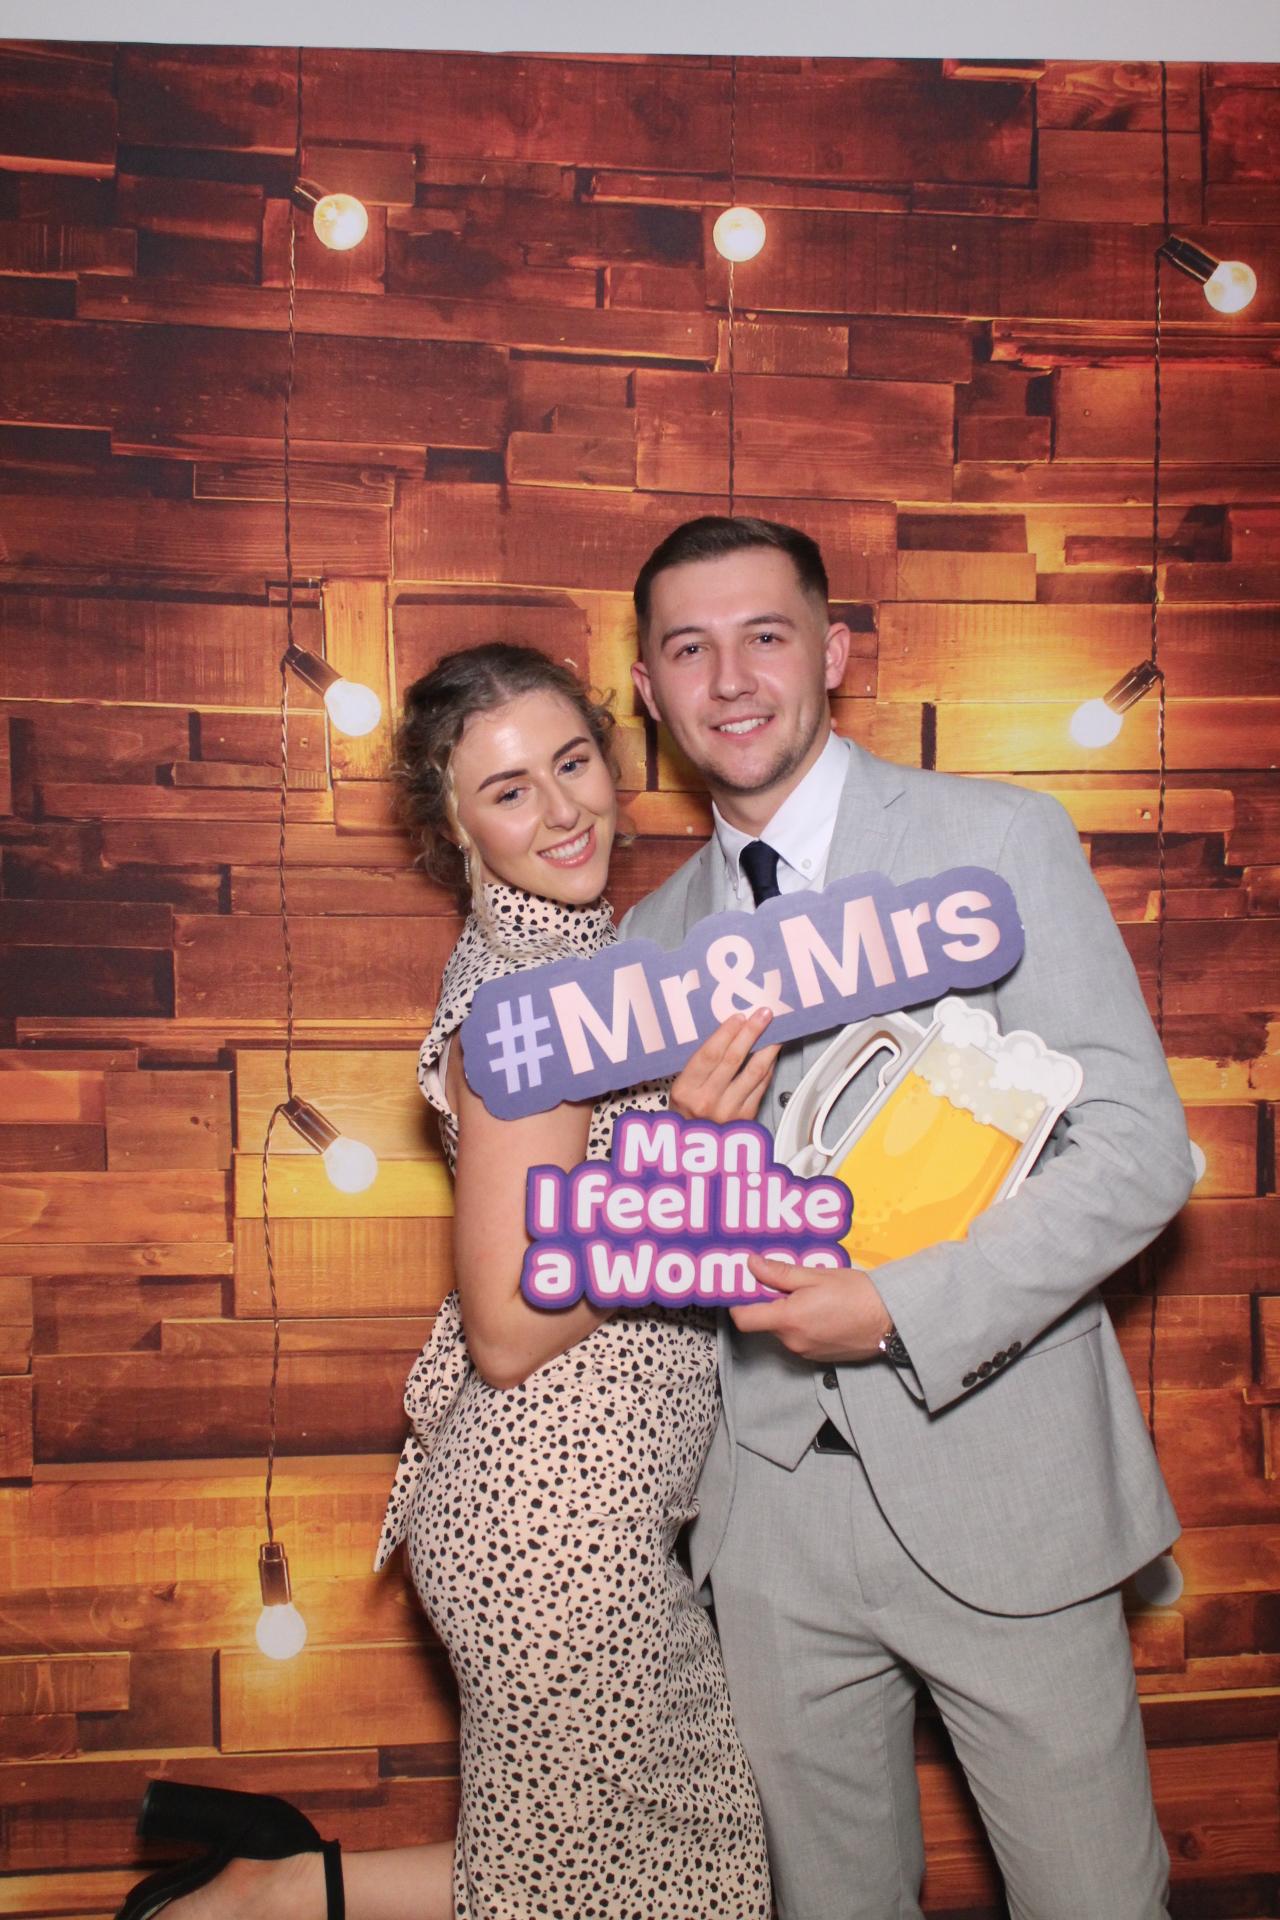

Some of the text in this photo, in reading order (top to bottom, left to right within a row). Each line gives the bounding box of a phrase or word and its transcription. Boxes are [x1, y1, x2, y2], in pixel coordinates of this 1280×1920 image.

[485, 890, 1001, 1094] #Mr&Mrs
[623, 1123, 761, 1174] Man
[539, 1172, 842, 1229] I feel like
[534, 1252, 571, 1294] a
